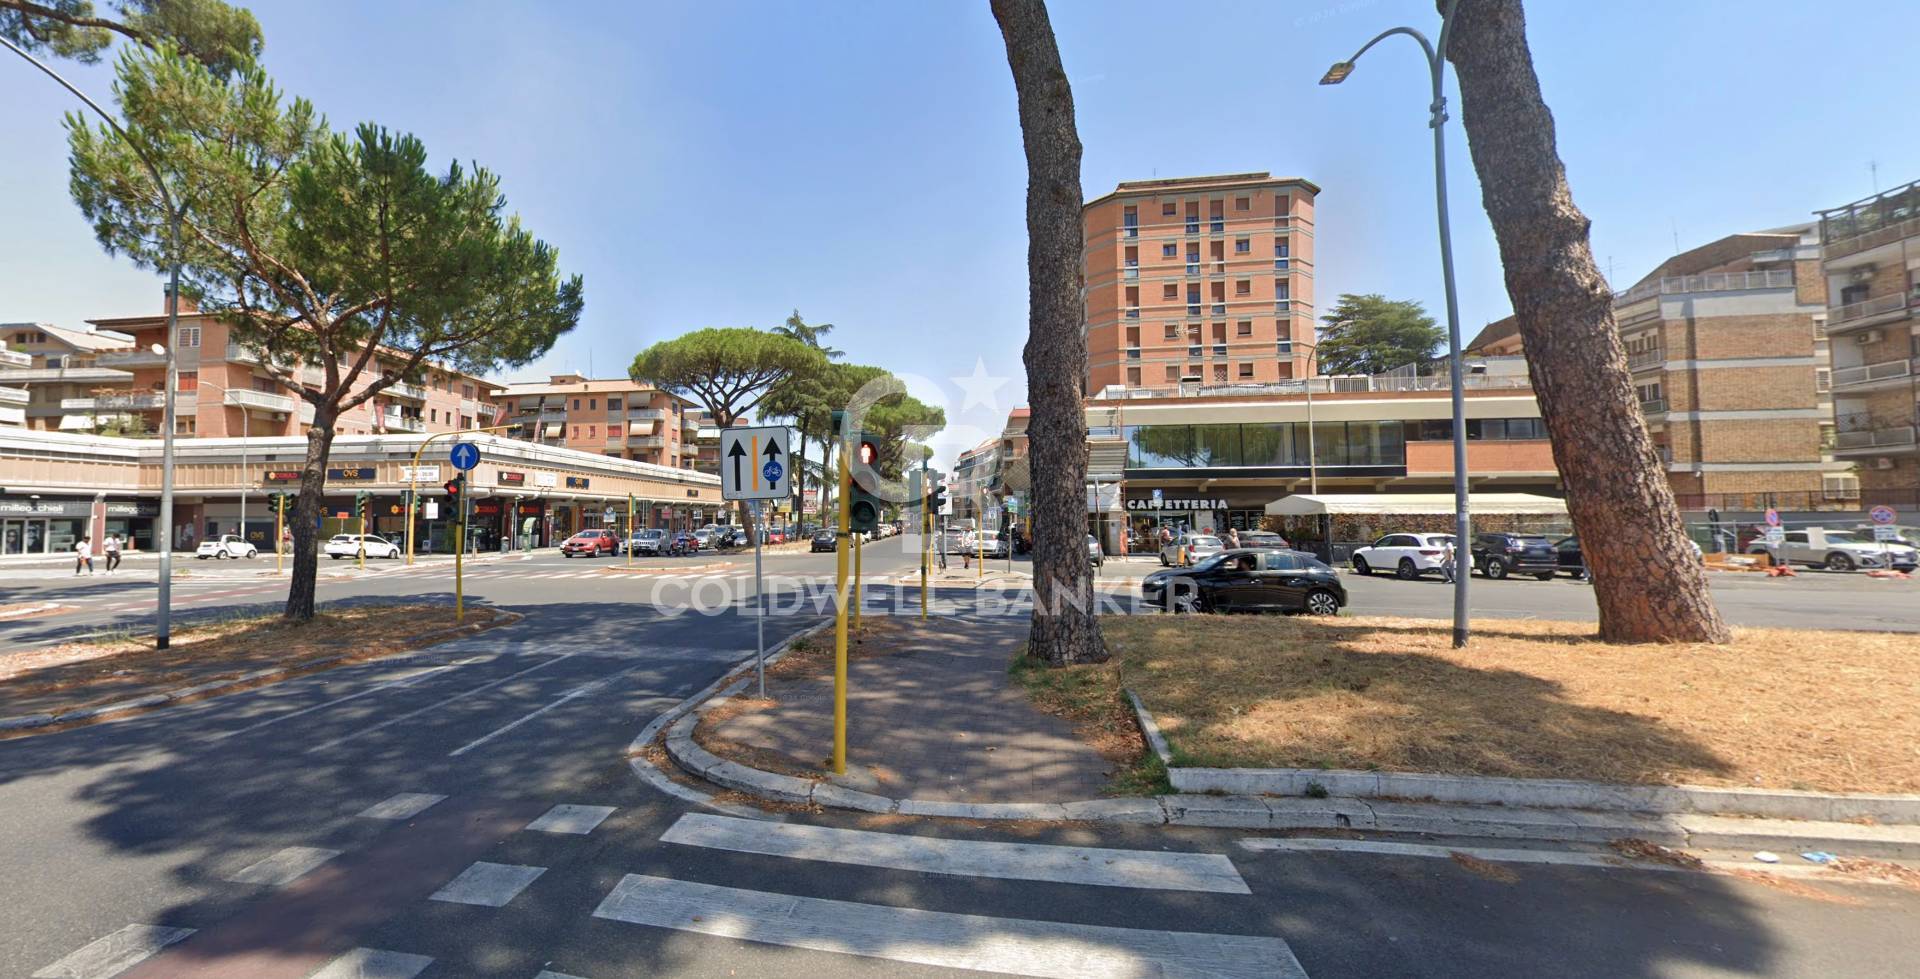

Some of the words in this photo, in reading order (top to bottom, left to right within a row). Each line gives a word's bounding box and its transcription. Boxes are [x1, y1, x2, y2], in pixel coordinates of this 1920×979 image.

[343, 469, 359, 477] OVS
[0, 504, 64, 513] milleochiali
[1127, 499, 1228, 510] CAFETTERIA
